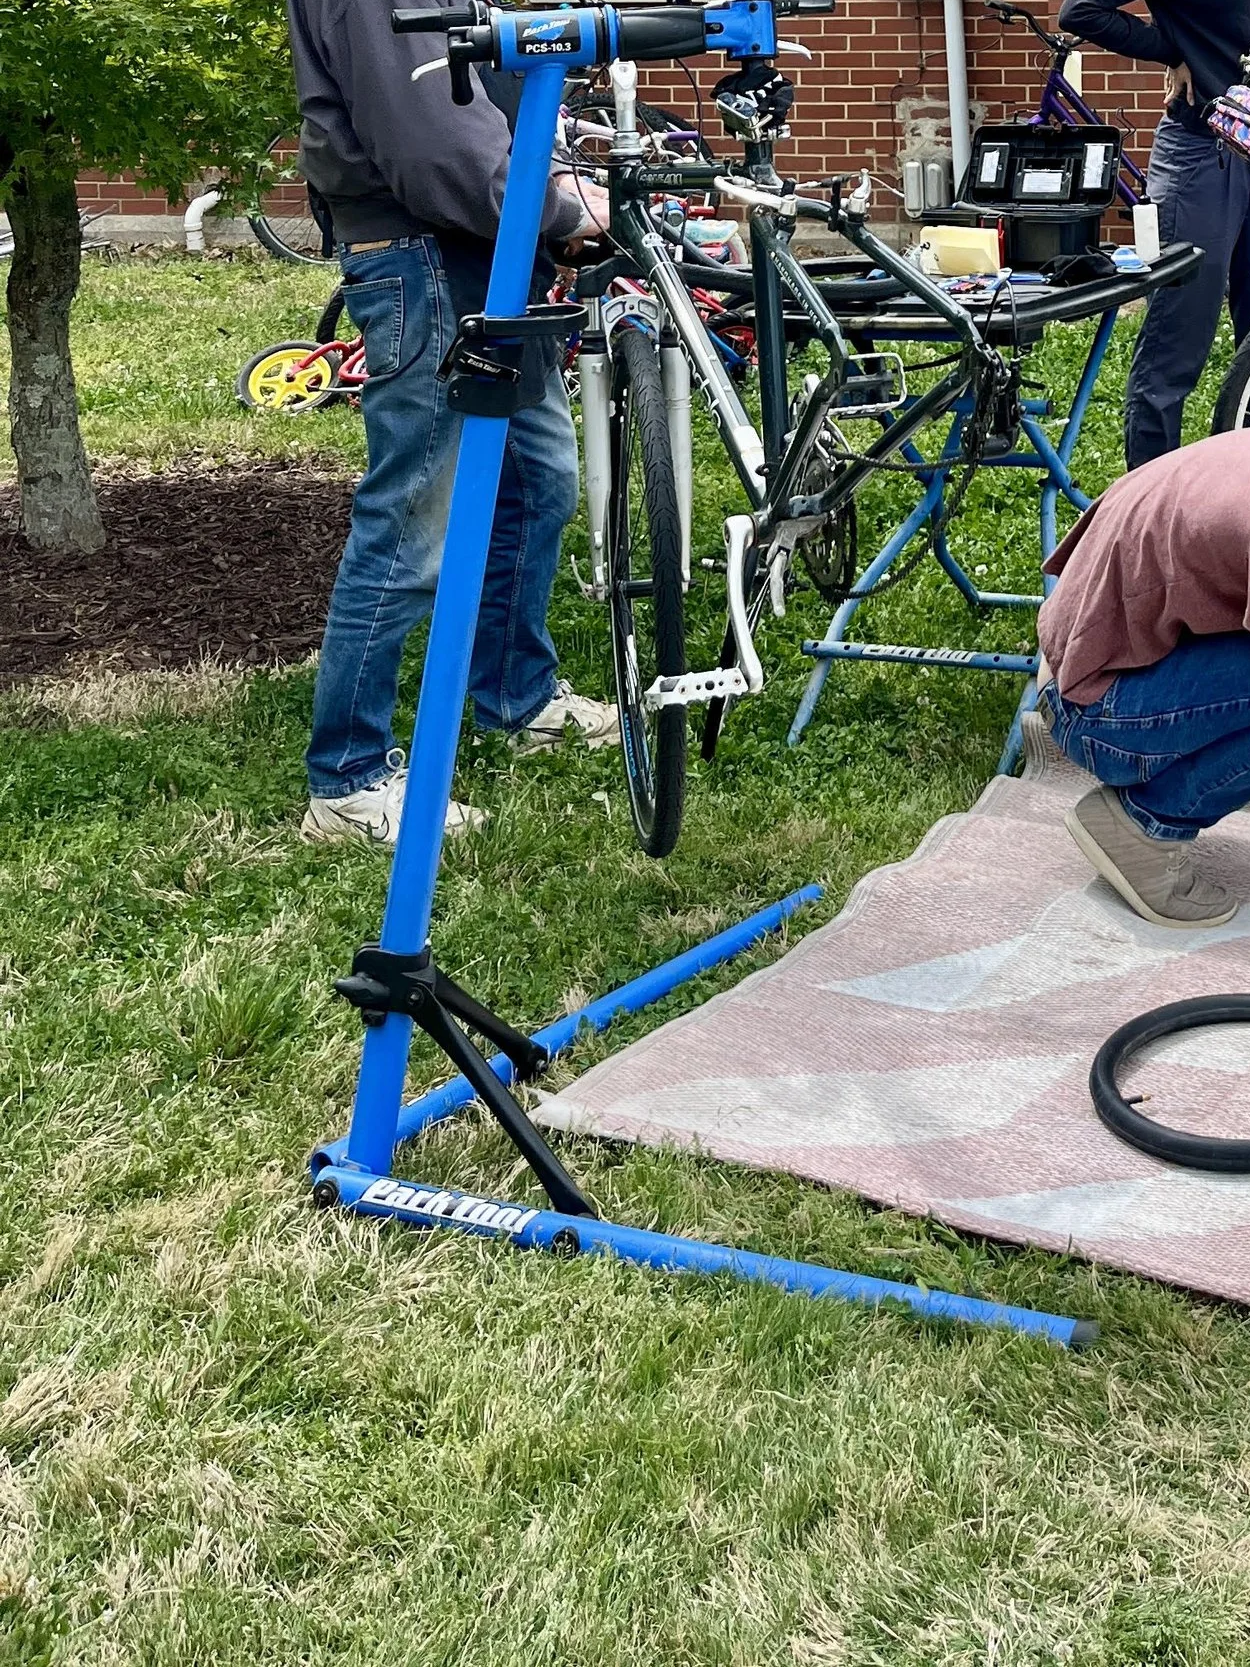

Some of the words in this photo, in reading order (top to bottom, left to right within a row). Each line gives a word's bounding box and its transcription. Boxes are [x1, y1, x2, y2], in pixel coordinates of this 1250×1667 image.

[525, 42, 572, 54] PCS-10.3
[361, 1178, 454, 1216] Park
[452, 1195, 542, 1234] Tool
